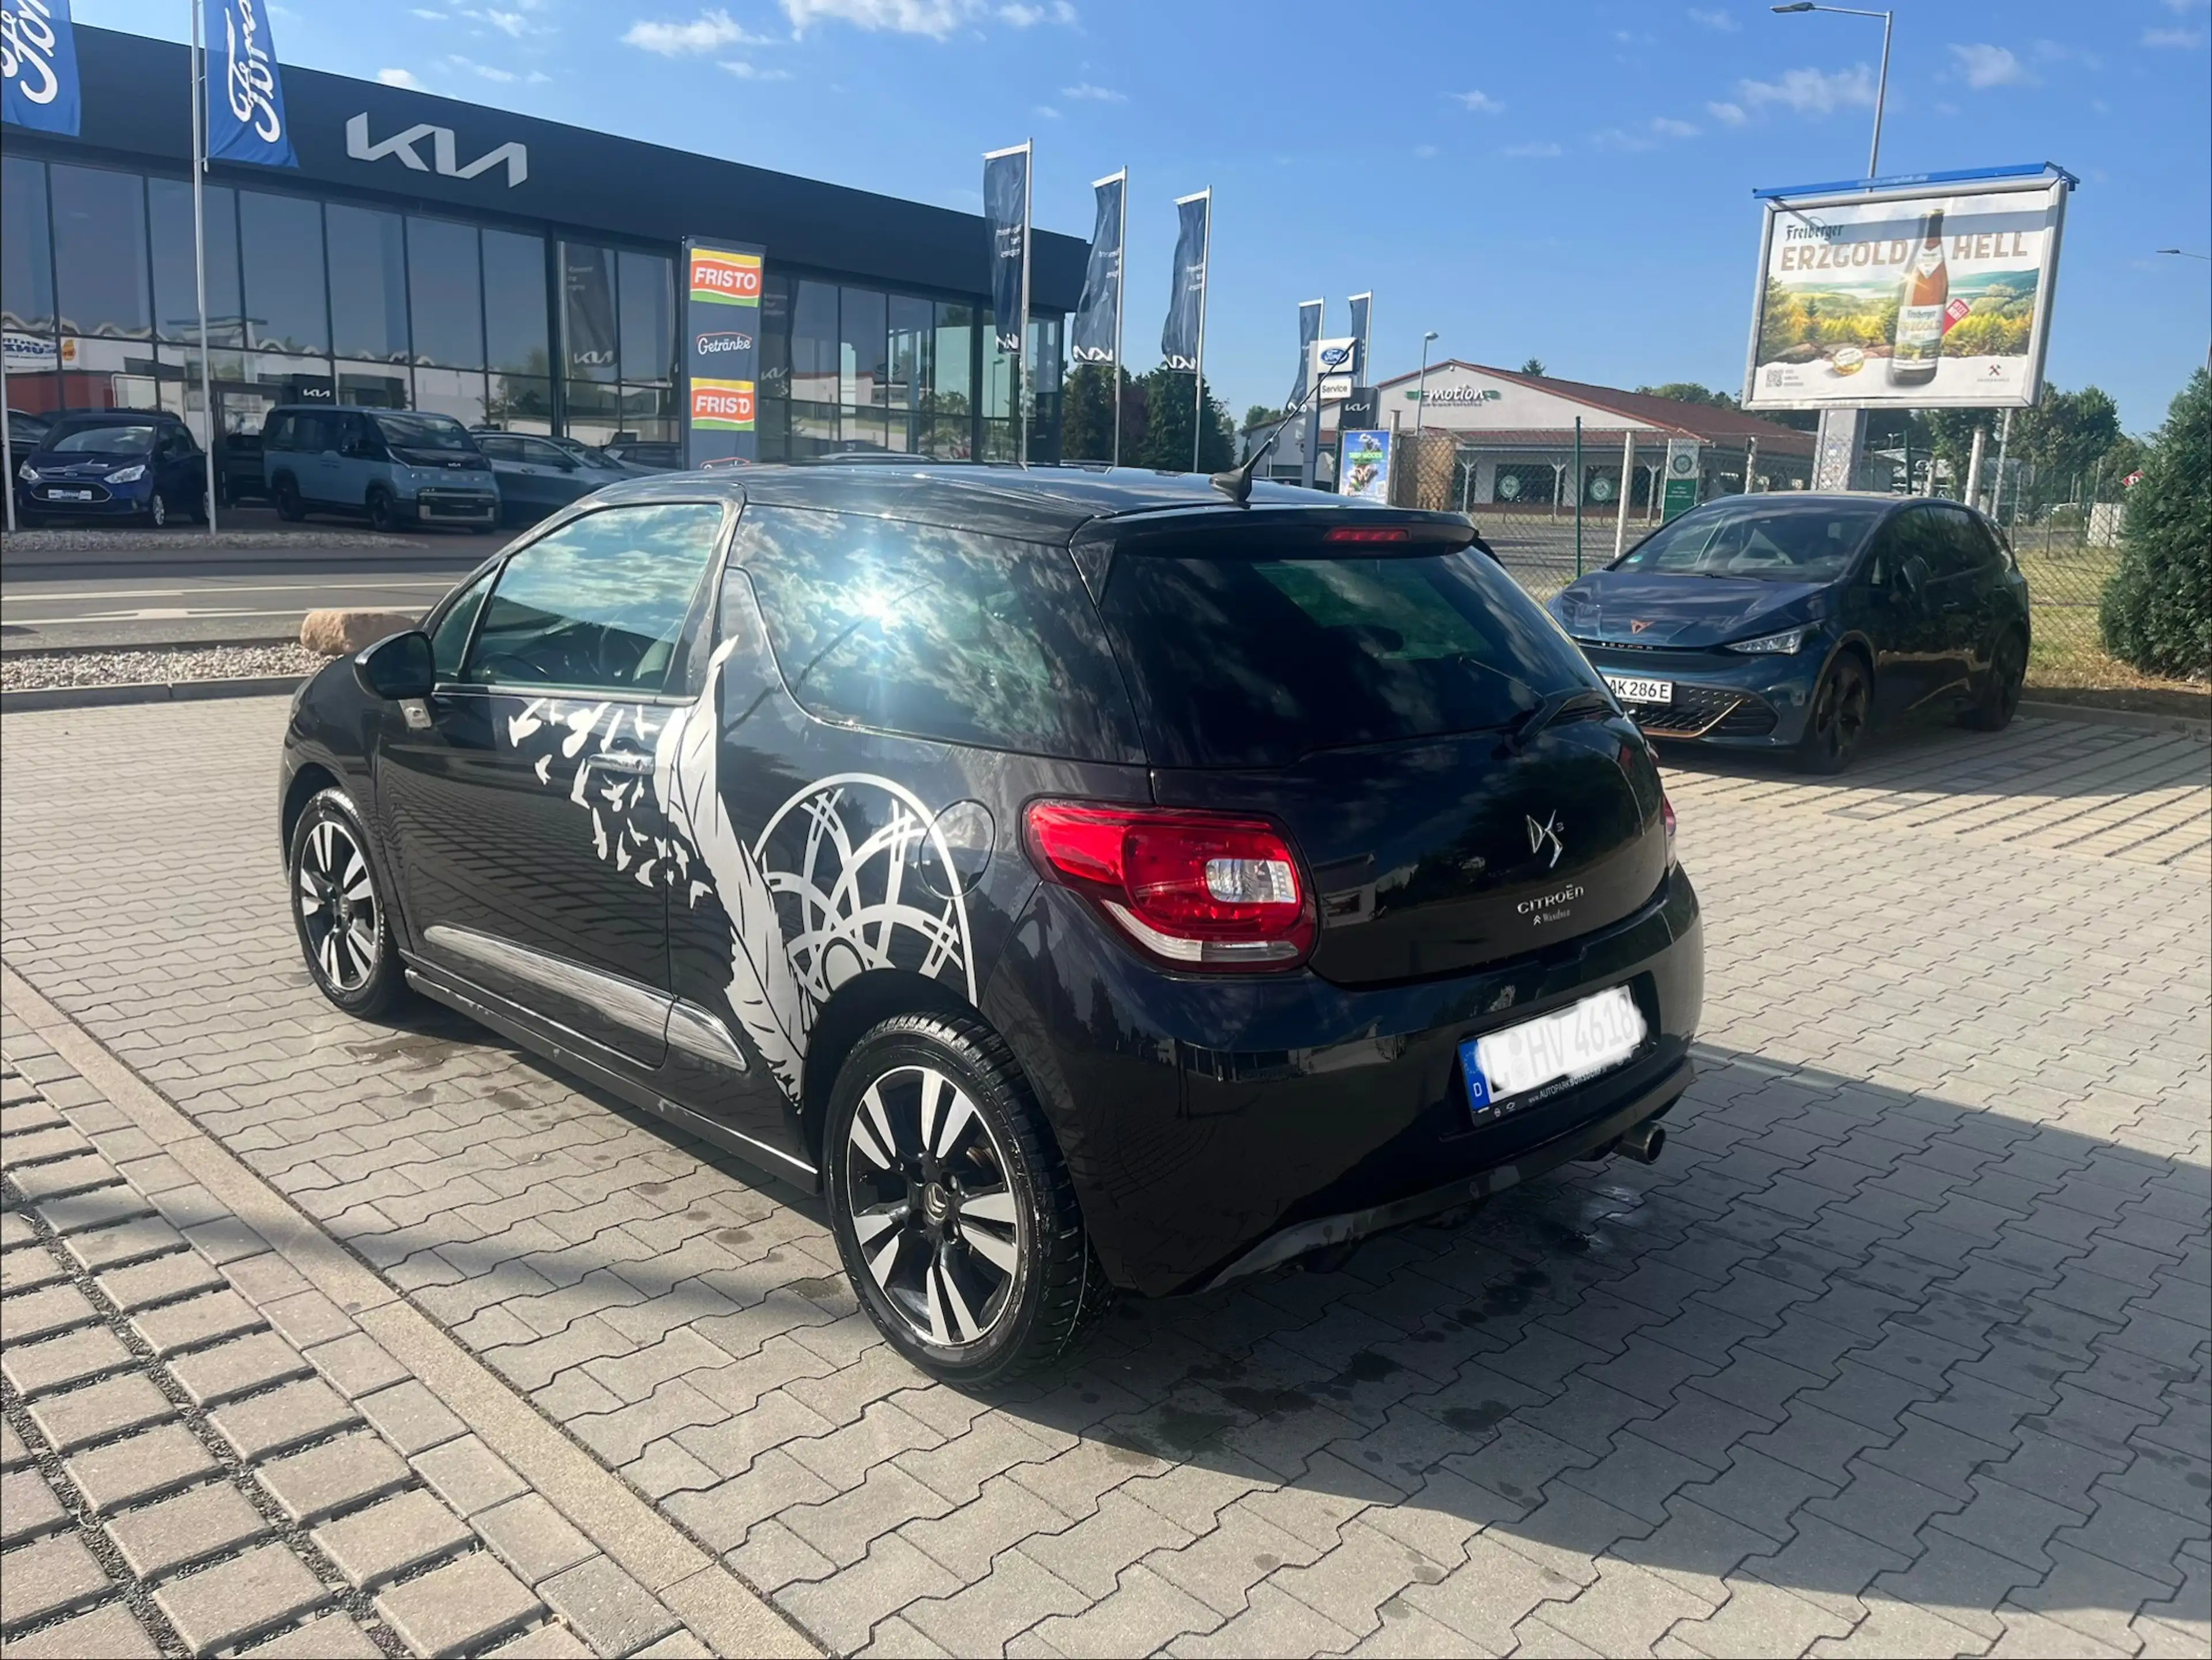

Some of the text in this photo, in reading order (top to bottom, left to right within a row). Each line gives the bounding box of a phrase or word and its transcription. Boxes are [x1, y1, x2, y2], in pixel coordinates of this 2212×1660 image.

[346, 111, 527, 188] KIA
[1786, 219, 1845, 242] Freiberger
[1781, 239, 1908, 271] ERZGOLD
[1952, 231, 2028, 260] HELL
[694, 266, 757, 290] FRISTO
[698, 336, 751, 356] Getränke
[1322, 385, 1348, 393] Service
[1344, 403, 1370, 412] KIA
